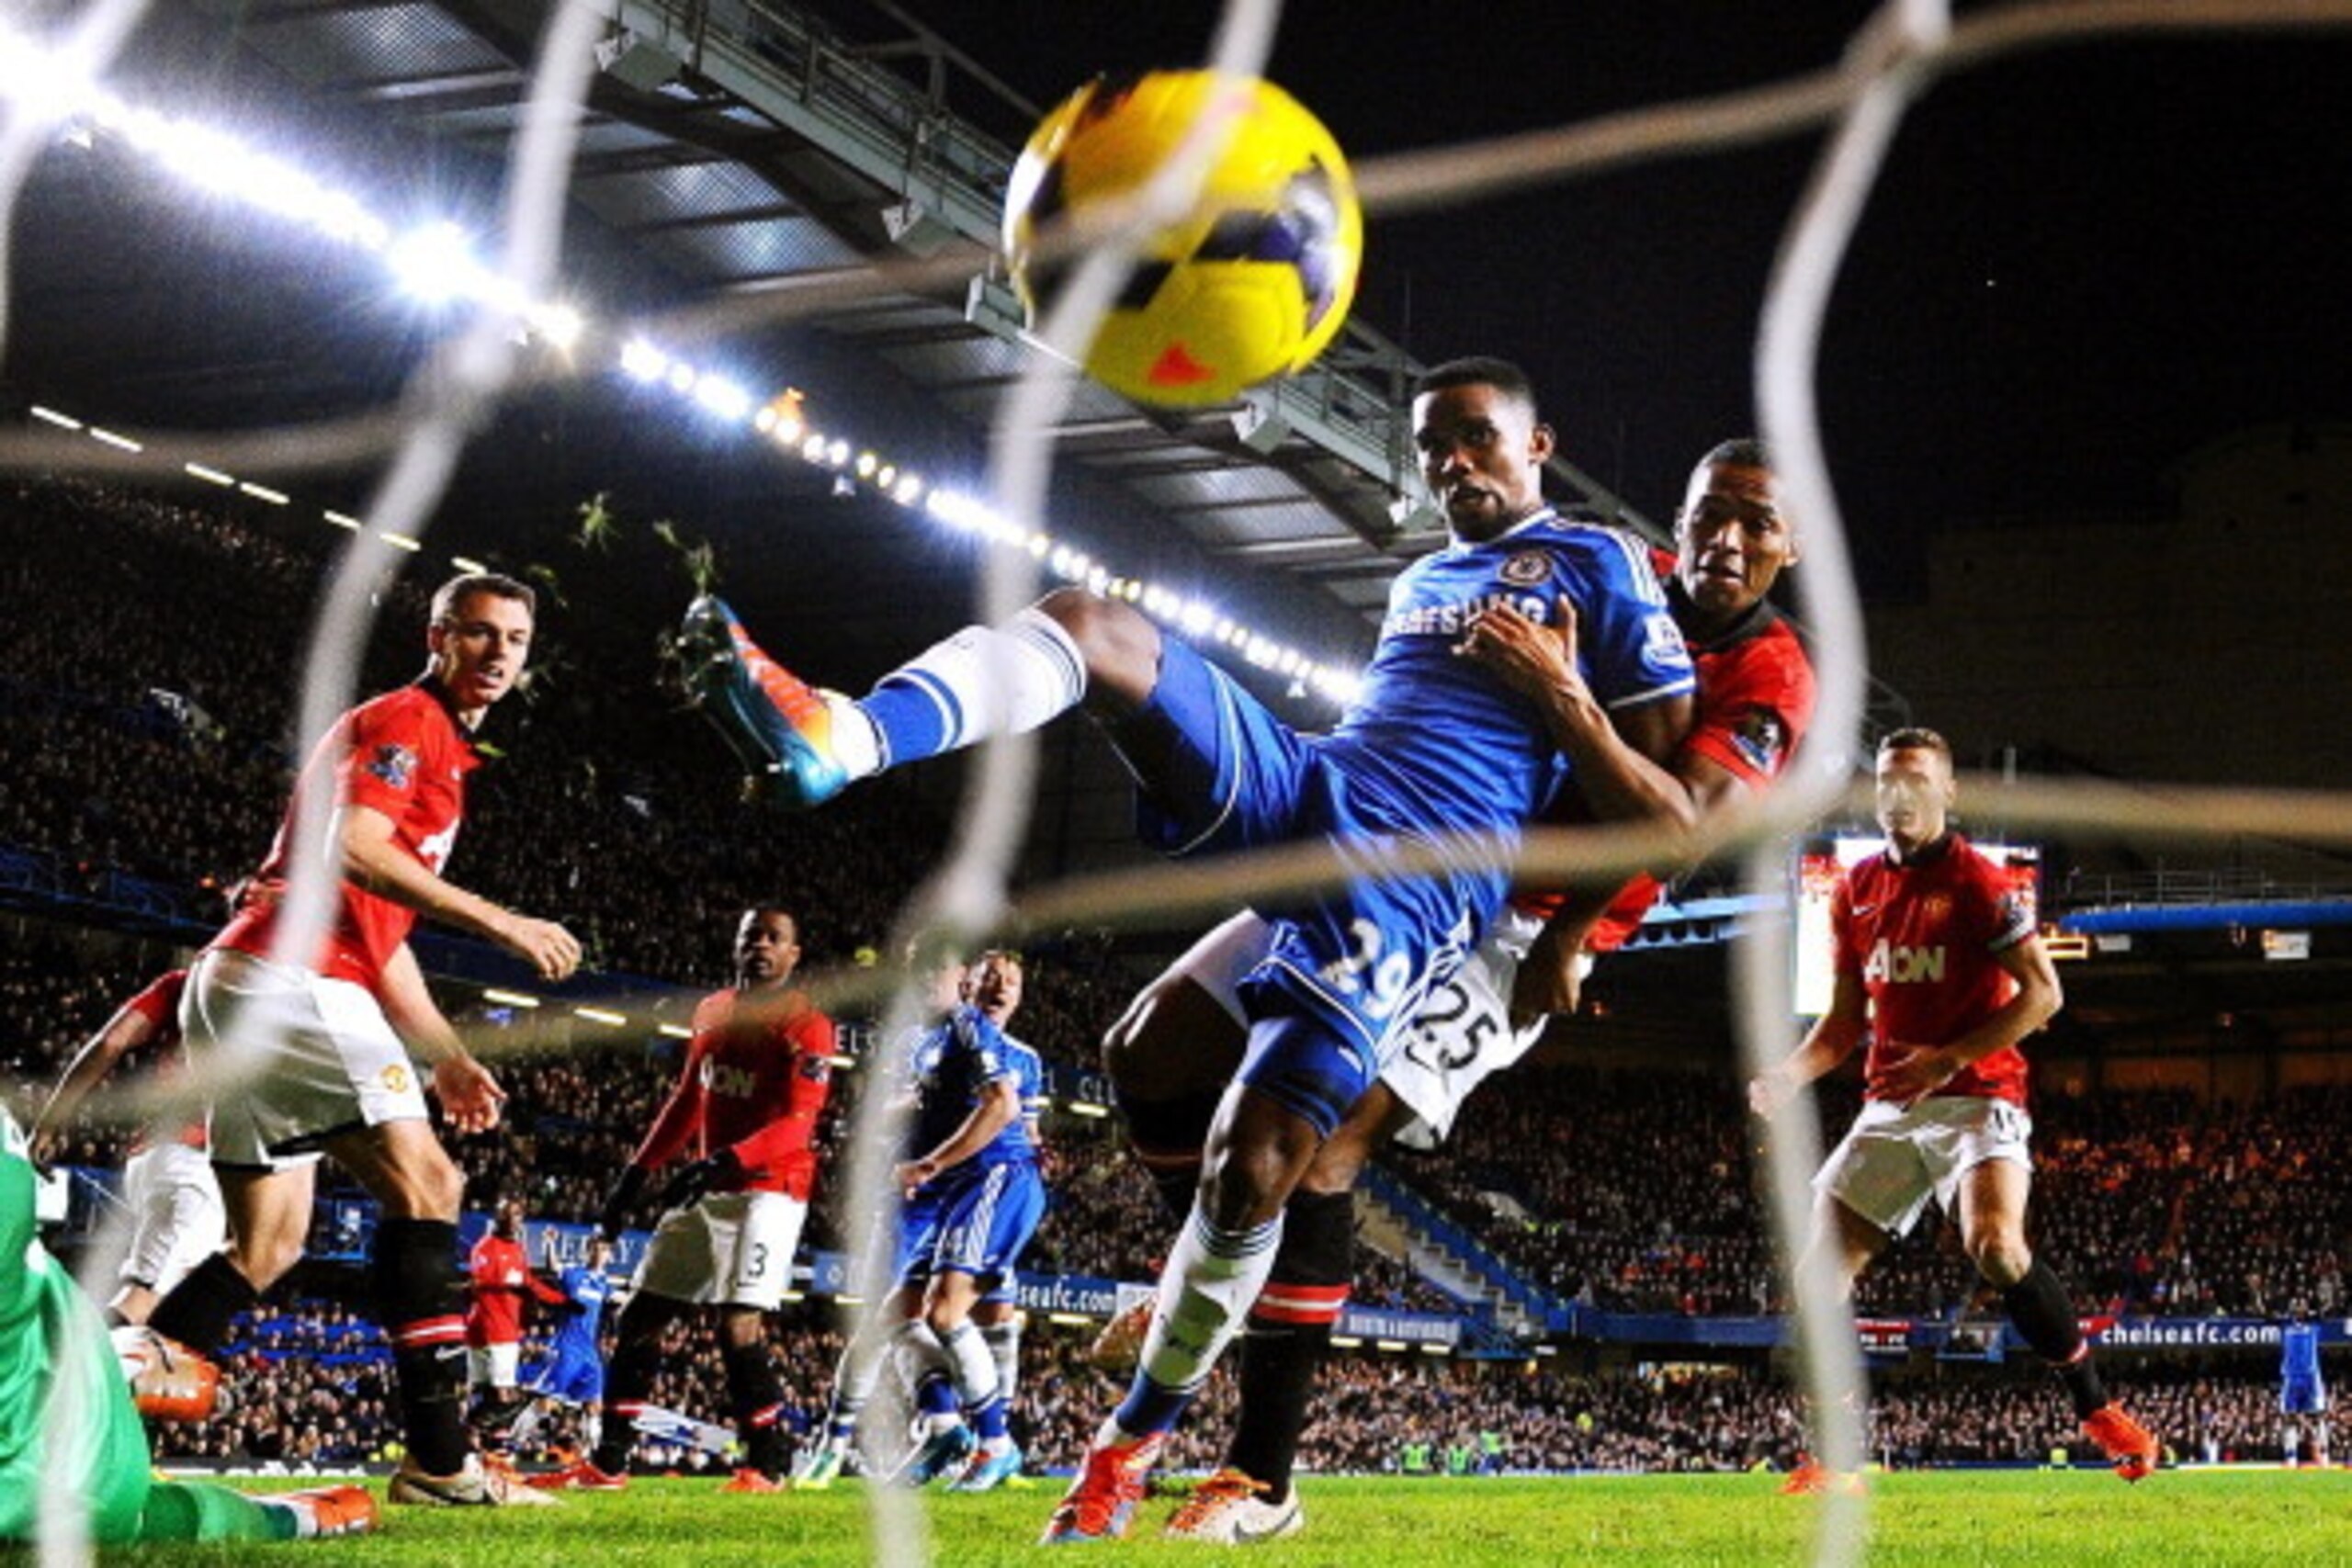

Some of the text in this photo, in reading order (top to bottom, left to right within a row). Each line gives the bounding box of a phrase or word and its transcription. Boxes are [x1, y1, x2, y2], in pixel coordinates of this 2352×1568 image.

[1317, 919, 1411, 1020] 29
[1863, 938, 1946, 983] AON
[1412, 982, 1498, 1069] 25
[748, 1242, 768, 1278] 3
[1020, 1274, 1114, 1312] seafc.com
[2100, 1321, 2282, 1344] chelseafc.com
